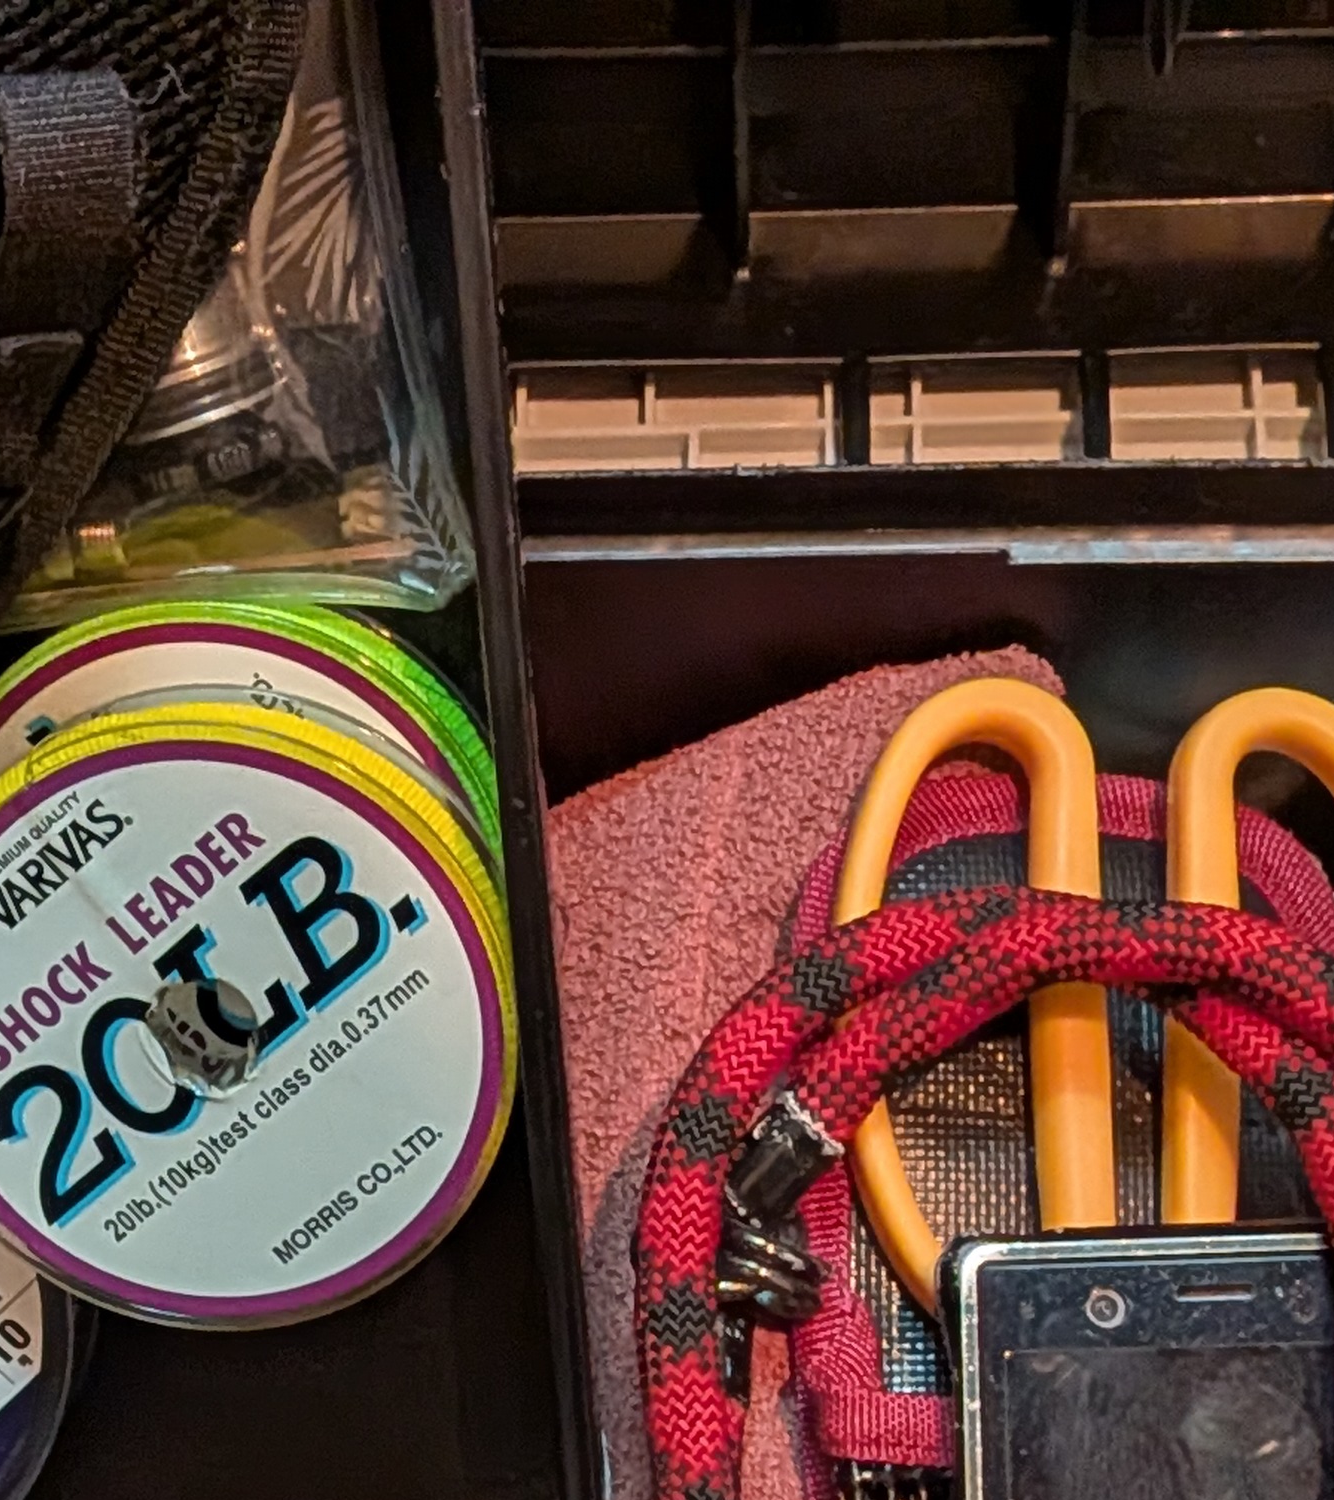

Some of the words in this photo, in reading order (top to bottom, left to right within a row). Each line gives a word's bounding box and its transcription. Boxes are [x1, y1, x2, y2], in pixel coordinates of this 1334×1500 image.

[28, 790, 81, 841] QUALITY
[105, 812, 267, 955] LEADER
[253, 1066, 312, 1120] class
[308, 968, 431, 1075] dia.0.37mm
[271, 1189, 360, 1265] MORRIS
